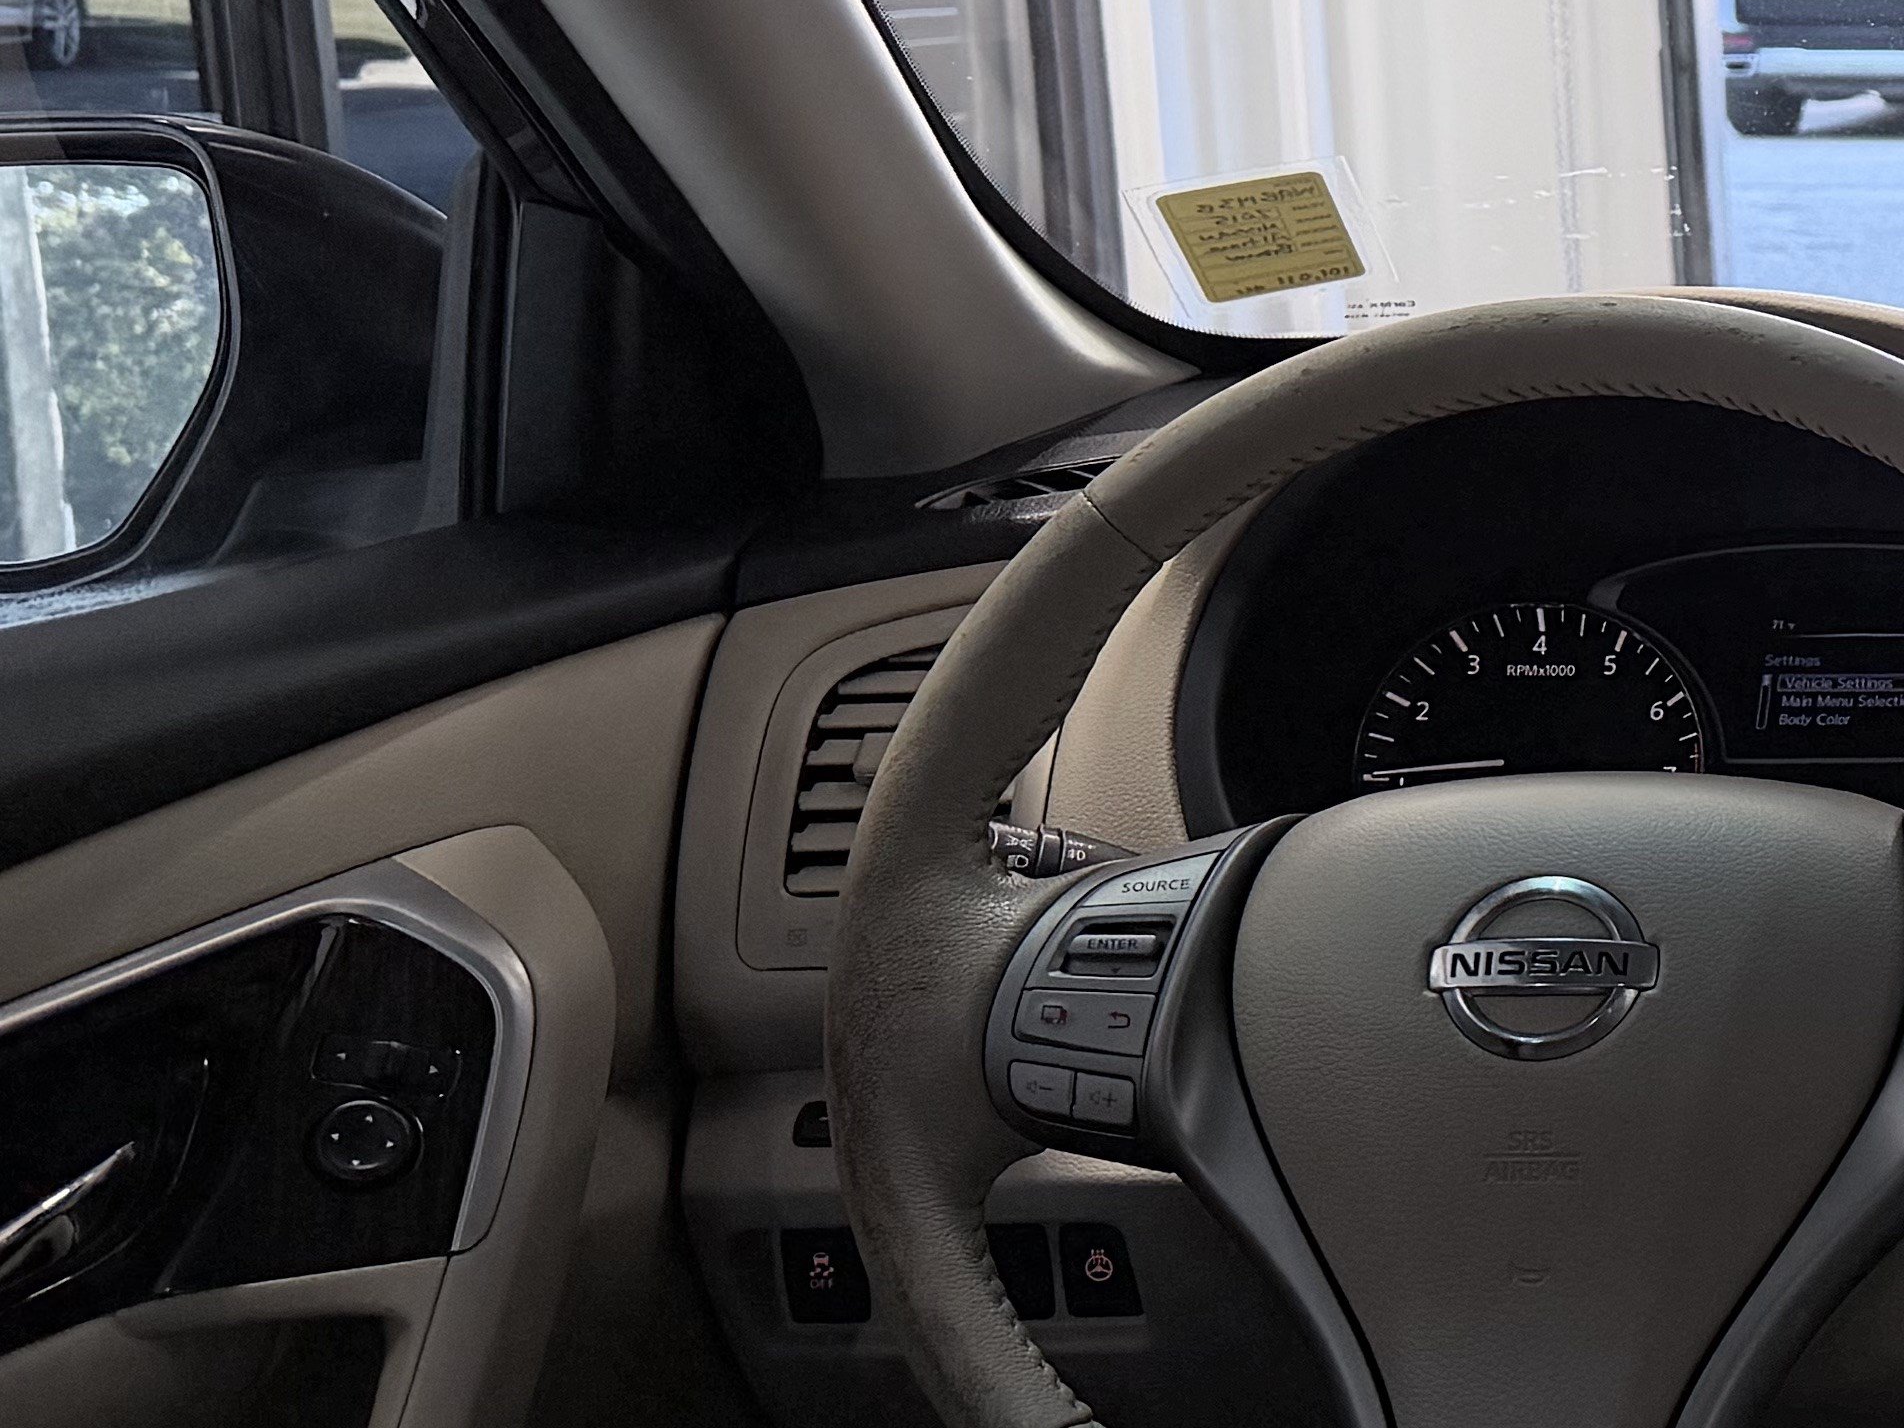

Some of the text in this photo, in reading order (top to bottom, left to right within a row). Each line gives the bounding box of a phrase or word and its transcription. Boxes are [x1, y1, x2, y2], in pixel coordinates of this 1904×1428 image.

[1533, 635, 1547, 654] 4
[1467, 655, 1480, 674] 3
[1604, 655, 1616, 674] 5
[1415, 702, 1429, 721] 2
[1650, 701, 1664, 721] 6
[1121, 878, 1190, 894] SOURCE
[1086, 937, 1138, 951] ENTER
[1449, 948, 1630, 979] NISSAN
